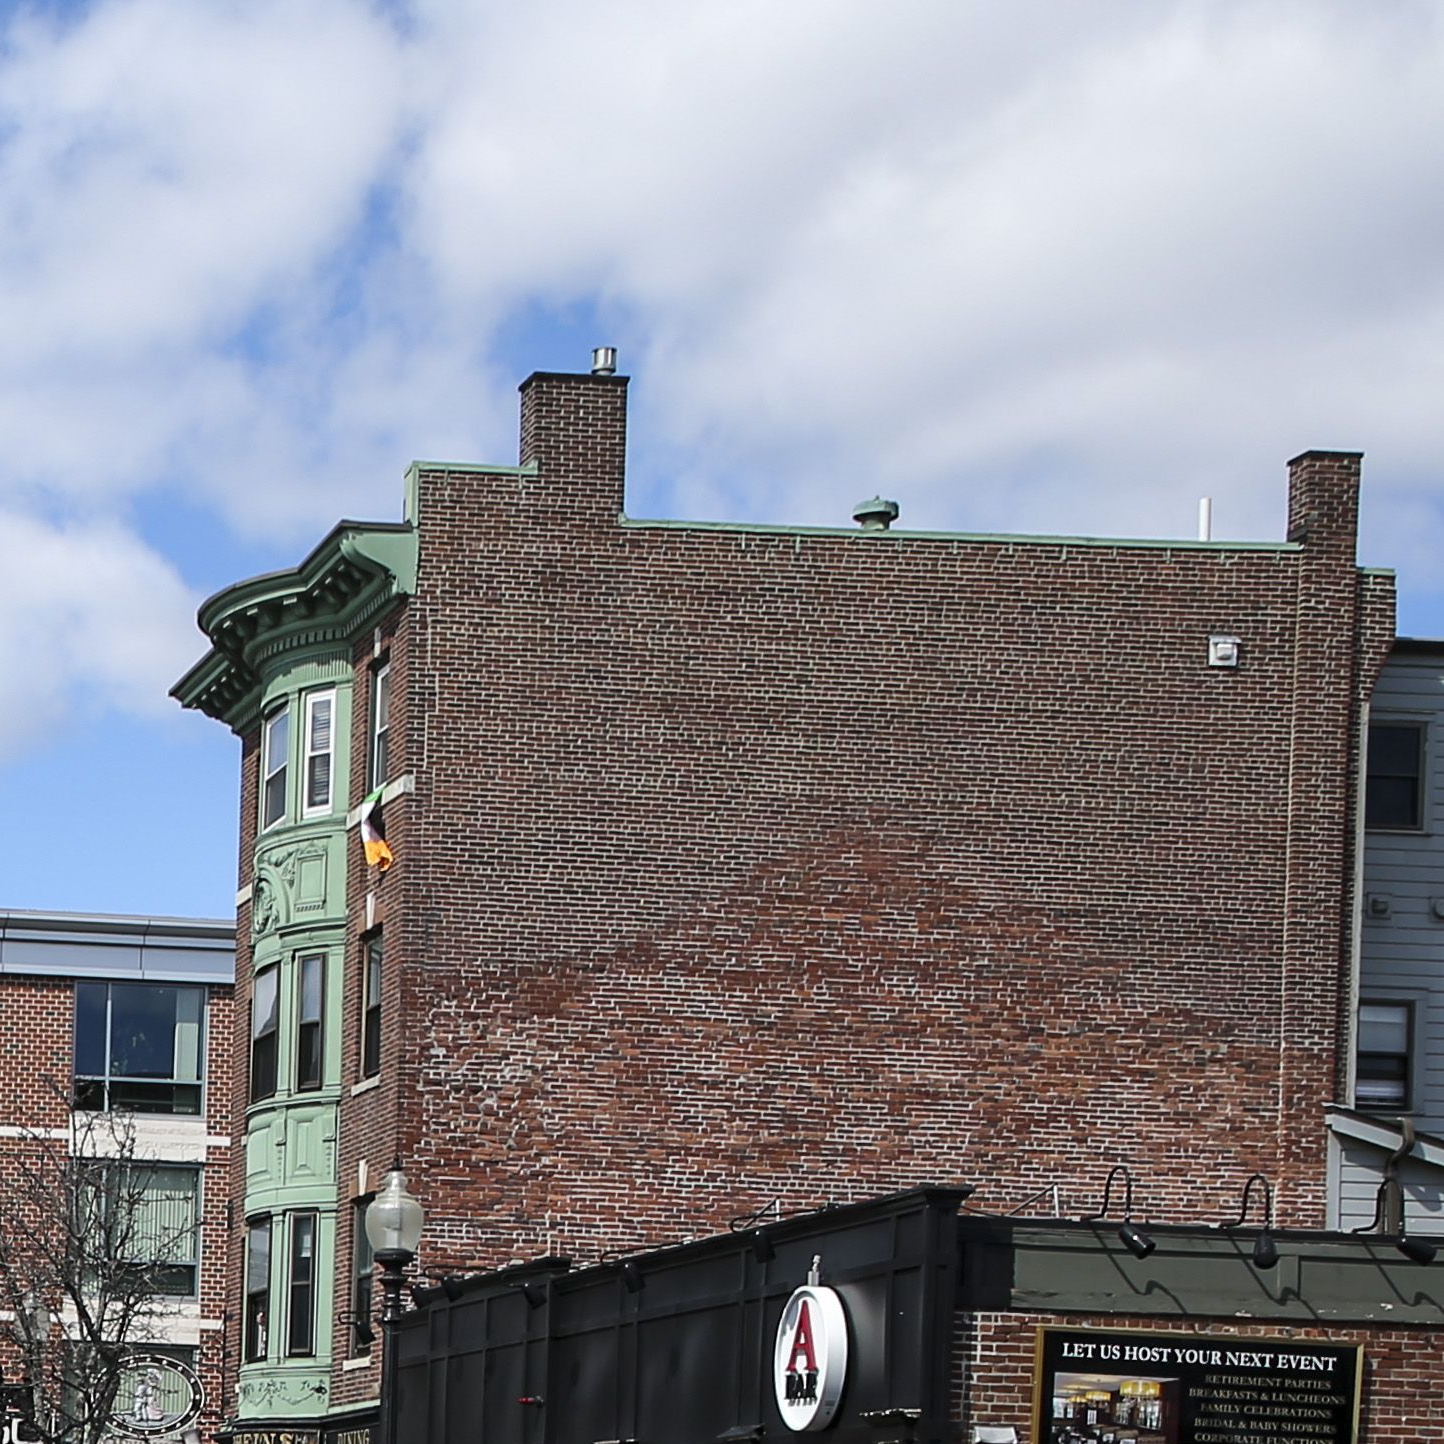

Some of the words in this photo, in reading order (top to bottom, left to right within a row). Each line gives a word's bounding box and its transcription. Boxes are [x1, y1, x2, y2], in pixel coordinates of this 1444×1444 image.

[785, 1299, 818, 1372] A
[1062, 1342, 1096, 1358] LET
[1100, 1345, 1121, 1360] US
[1124, 1346, 1171, 1363] HOST
[1174, 1348, 1222, 1366] YOUR
[1225, 1350, 1274, 1368] NEXT
[1277, 1353, 1338, 1372] EVENT
[1204, 1374, 1283, 1388] RETIREMENT
[1284, 1378, 1332, 1390] PARTIES
[1188, 1387, 1258, 1401] BREAKFASTS
[1259, 1392, 1270, 1401] &
[1271, 1392, 1346, 1405] LUNCHEONS
[1200, 1402, 1243, 1413] FAMILY
[1243, 1404, 1333, 1419] CELEBRATIONS
[1194, 1417, 1236, 1429] BRIDAL
[1238, 1420, 1247, 1429] &
[1249, 1420, 1280, 1431] BABY
[1281, 1422, 1337, 1434] SHOWERS
